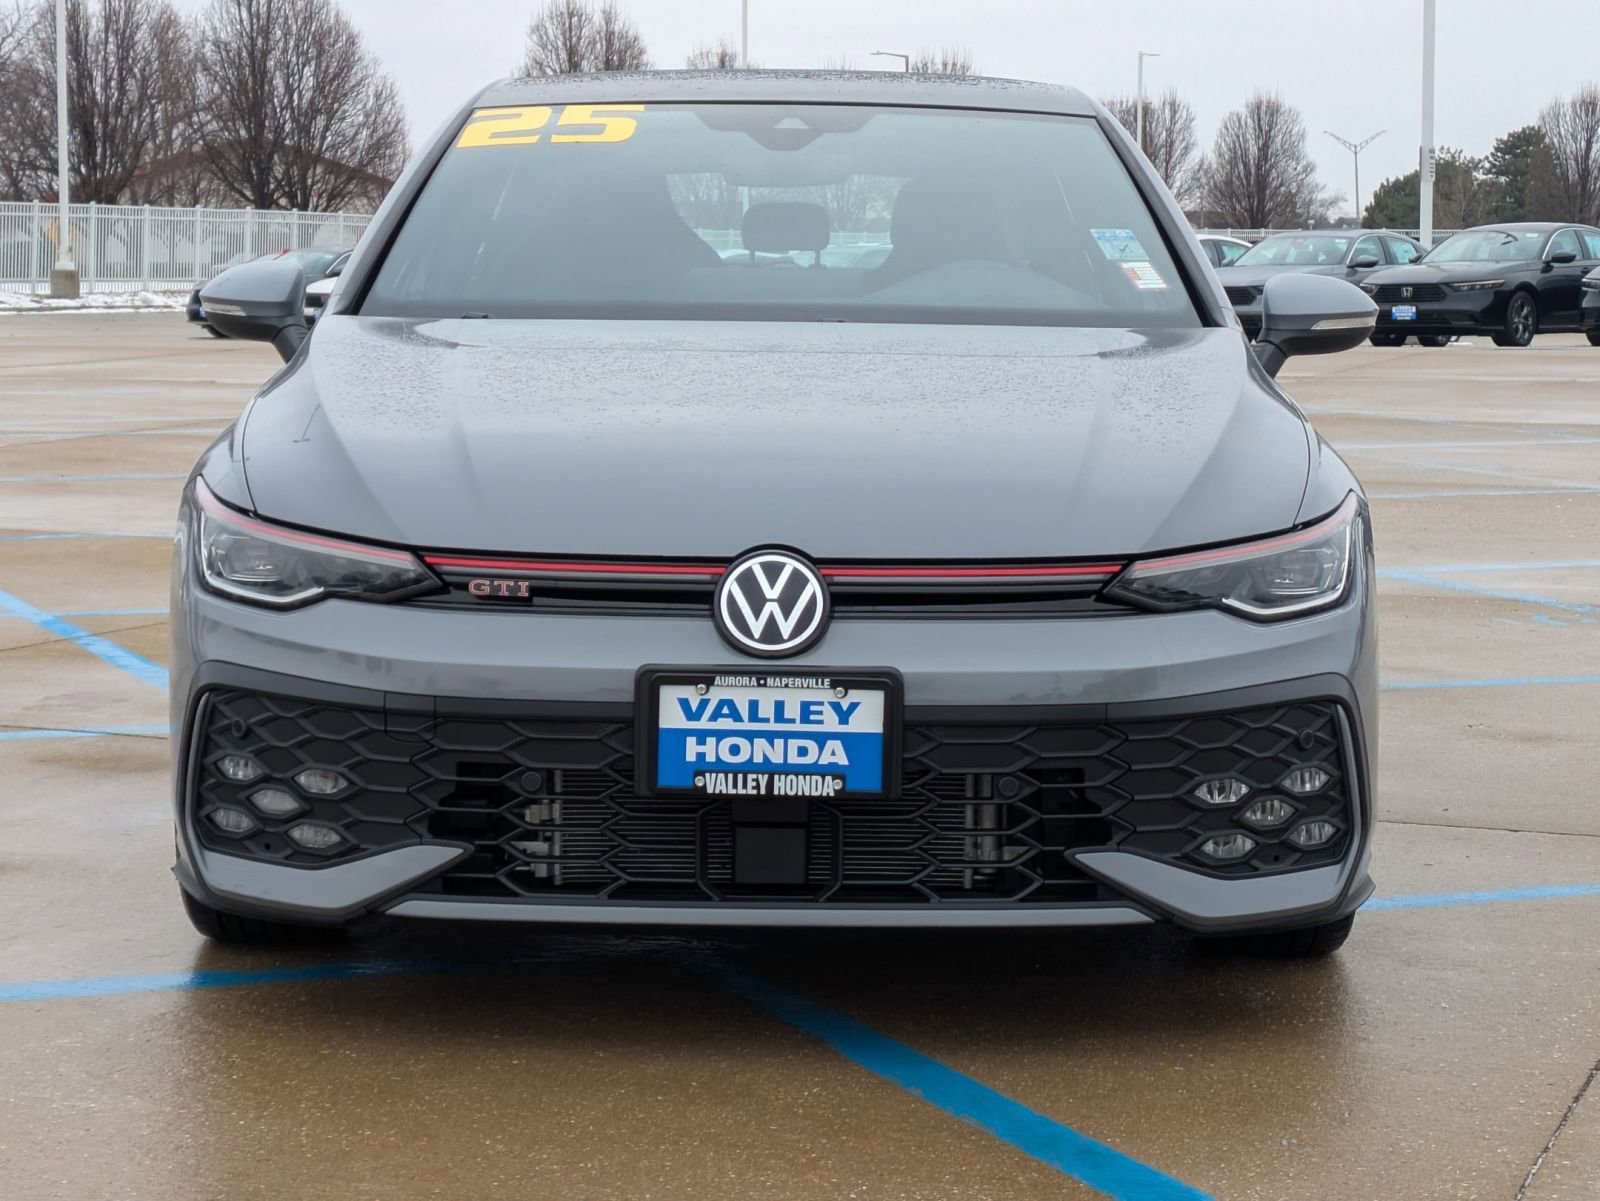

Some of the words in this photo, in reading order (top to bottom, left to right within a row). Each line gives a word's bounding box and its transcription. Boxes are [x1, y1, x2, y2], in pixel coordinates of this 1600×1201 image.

[456, 104, 645, 148] 25
[468, 579, 529, 597] GTI
[714, 676, 757, 688] AURORA
[766, 677, 831, 689] NAPERVILLE
[677, 697, 862, 726] VALLEY
[685, 736, 849, 766] HONDA
[705, 772, 769, 795] VALLEY
[773, 774, 835, 797] HONDA
